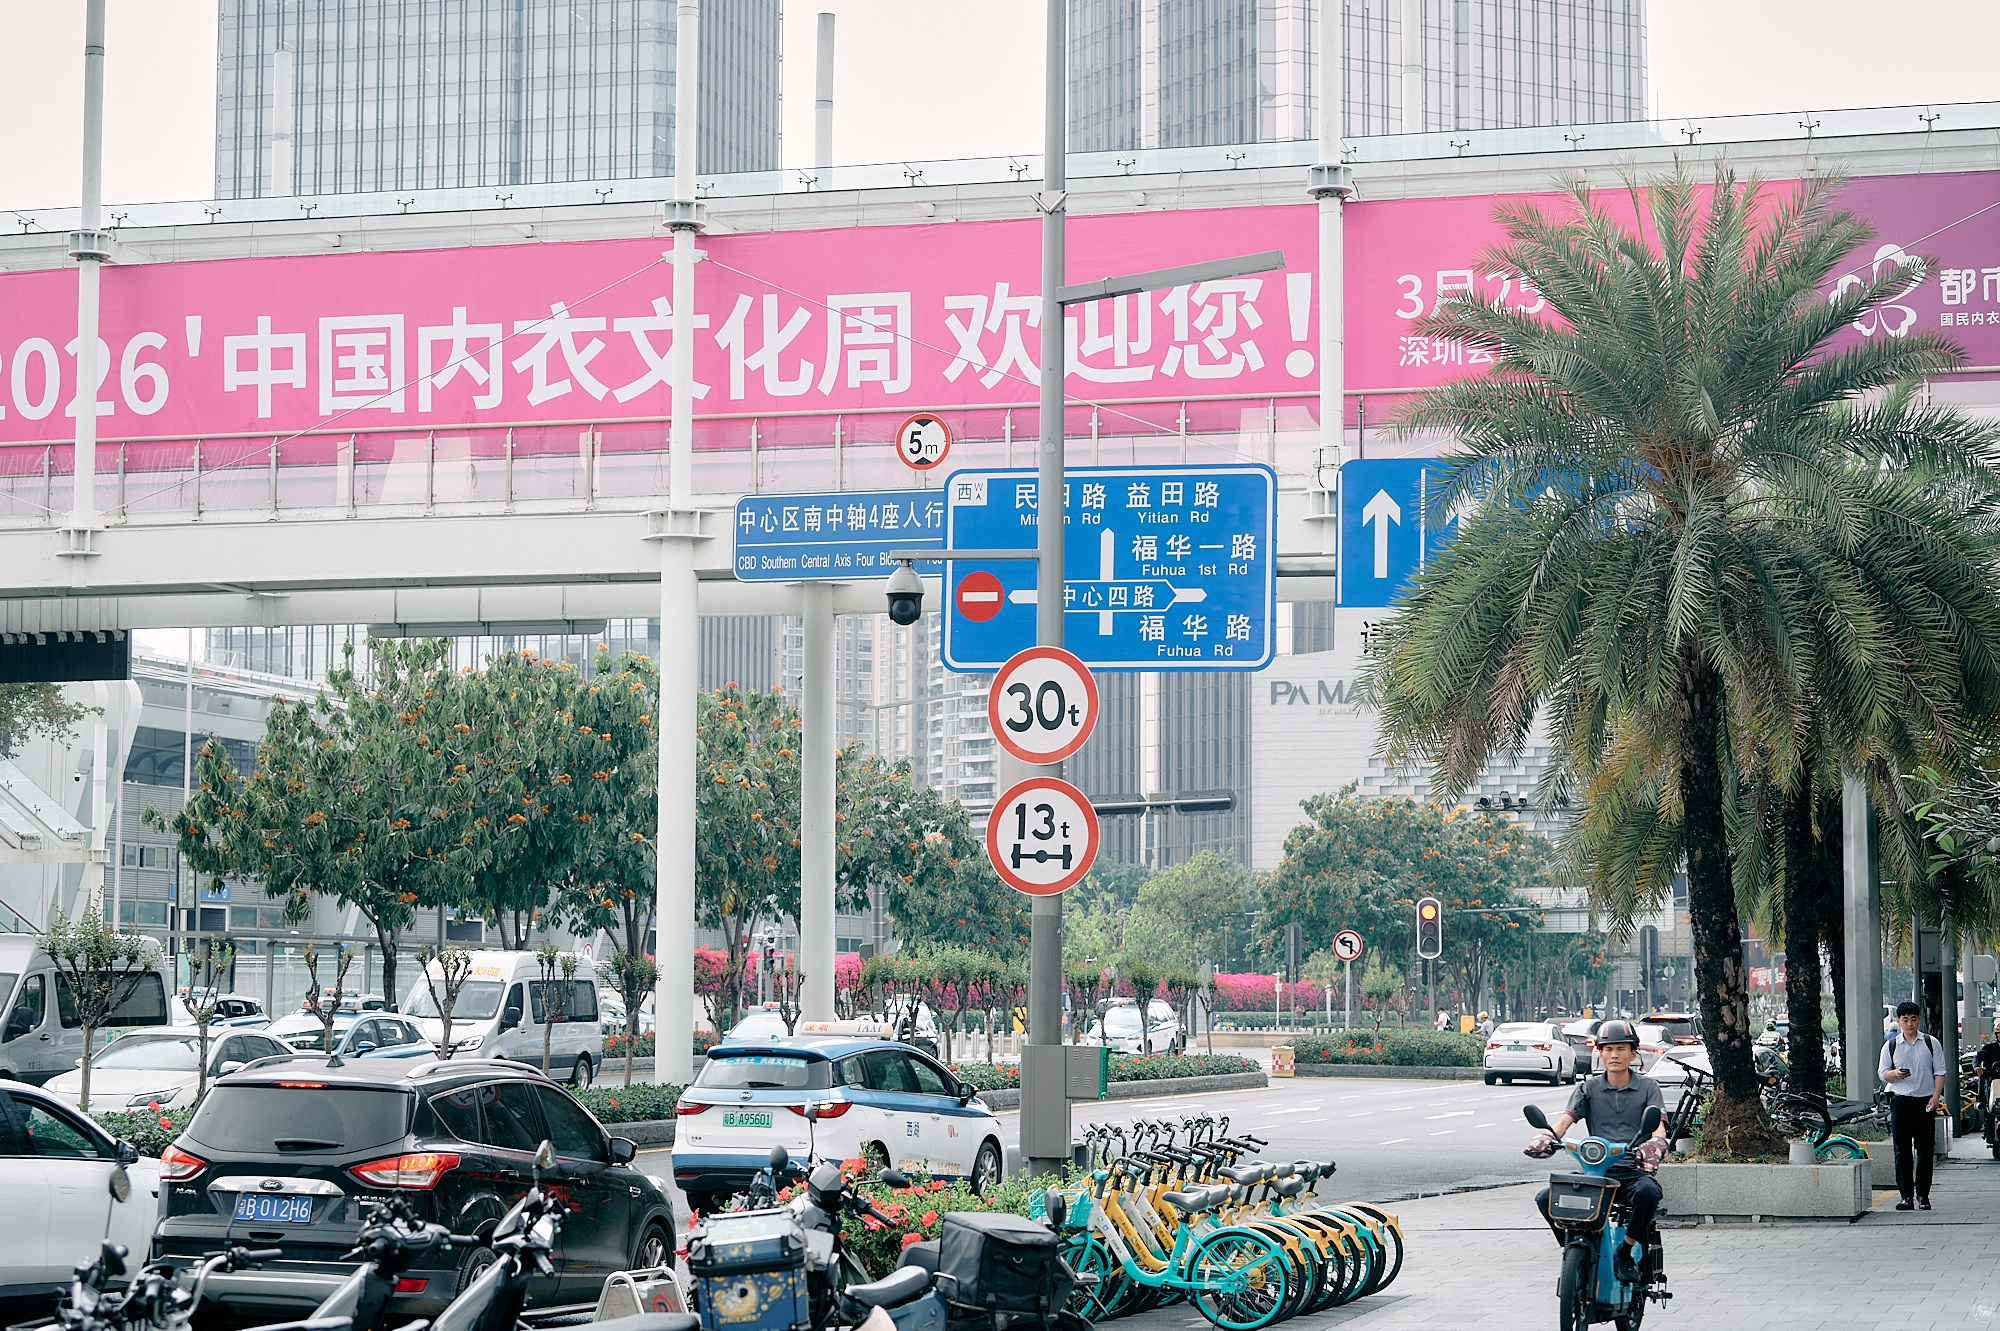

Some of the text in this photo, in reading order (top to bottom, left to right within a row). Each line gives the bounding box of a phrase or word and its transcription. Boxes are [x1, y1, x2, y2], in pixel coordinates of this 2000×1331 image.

[0, 292, 911, 421] 026'中国内衣文化周
[909, 430, 938, 455] 5m
[957, 482, 984, 501] 西 W
[1015, 481, 1220, 511] 民路 益田路
[1082, 512, 1101, 525] Rd
[1137, 512, 1179, 524] Yitian
[1190, 511, 1210, 523] Rd
[1131, 533, 1257, 562] 福华一路
[738, 556, 757, 571] CBD
[761, 555, 797, 570] Southern
[801, 554, 830, 569] Central
[834, 553, 852, 568] Axis
[856, 552, 875, 567] Four
[1142, 563, 1248, 577] Fuhua 1st Rd
[1064, 584, 1155, 608] 中心四路
[1139, 614, 1252, 642] 福华路
[1157, 644, 1234, 657] Fuhua Rd
[1005, 680, 1080, 732] 30t
[1015, 803, 1070, 840] 13t
[857, 1024, 882, 1033] TAXI
